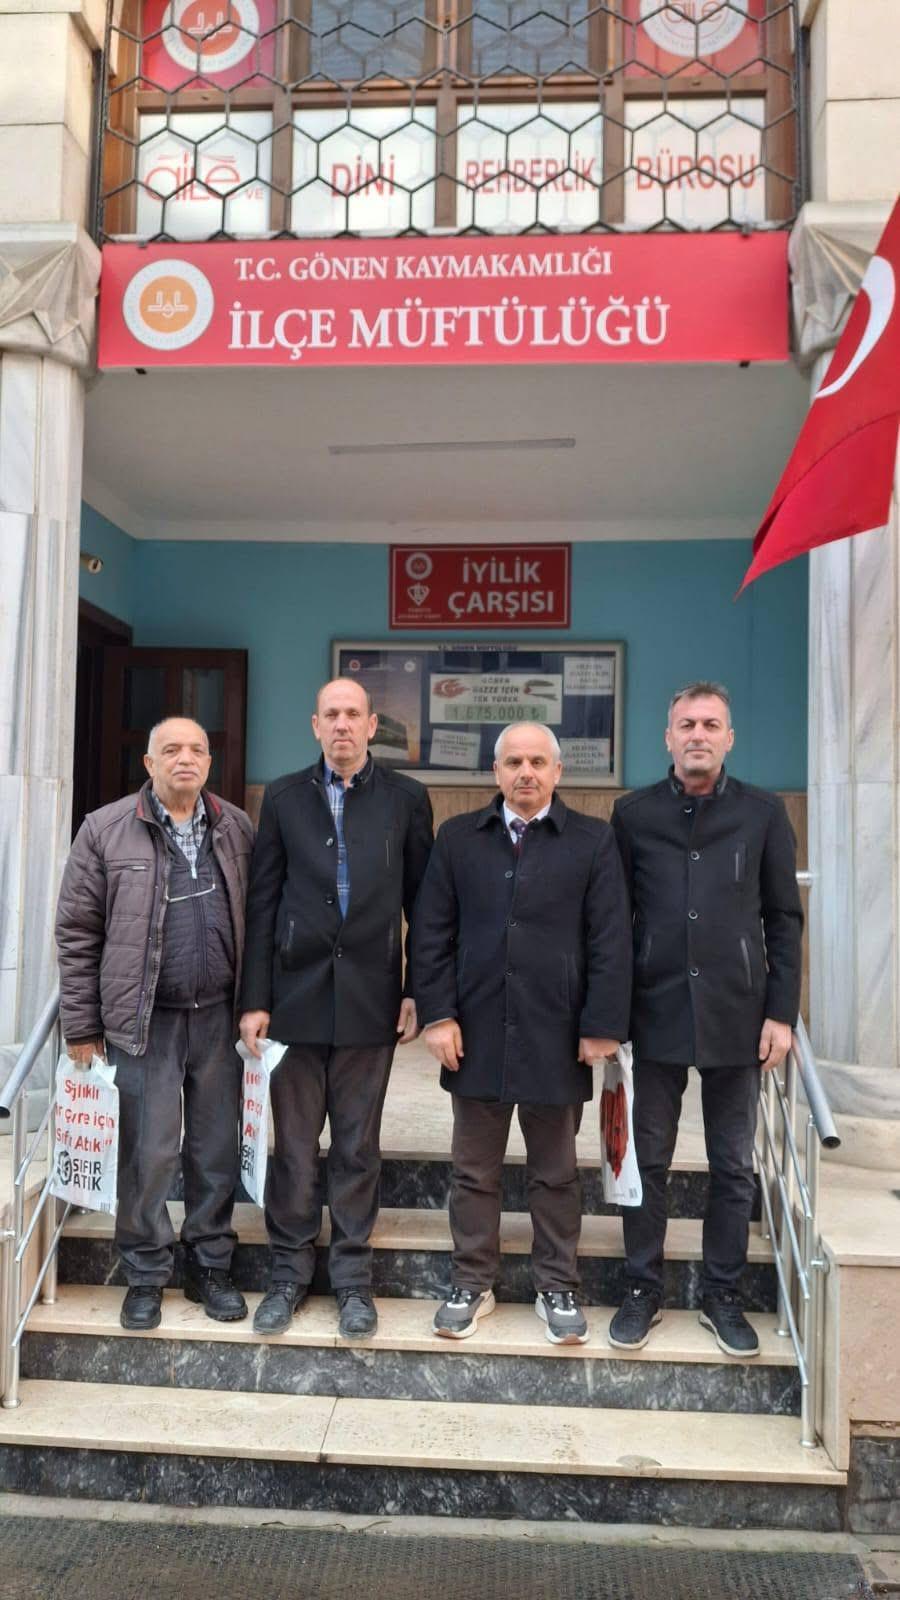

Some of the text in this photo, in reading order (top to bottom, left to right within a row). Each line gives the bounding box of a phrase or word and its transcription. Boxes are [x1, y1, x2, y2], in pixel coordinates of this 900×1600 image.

[331, 154, 395, 197] DİNİ
[465, 150, 597, 194] REHBERLİK
[636, 149, 757, 191] BÜROSU
[234, 247, 613, 280] T.C. GÖNEN KAYMAKAMLIĞI
[228, 301, 337, 360] İLÇE
[348, 296, 670, 349] MÜFTÜLÜĞÜ
[462, 556, 541, 583] İYİLİK
[448, 590, 555, 619] ÇARŞISI
[73, 1158, 102, 1175] SIFIR
[73, 1174, 102, 1191] ATIK
